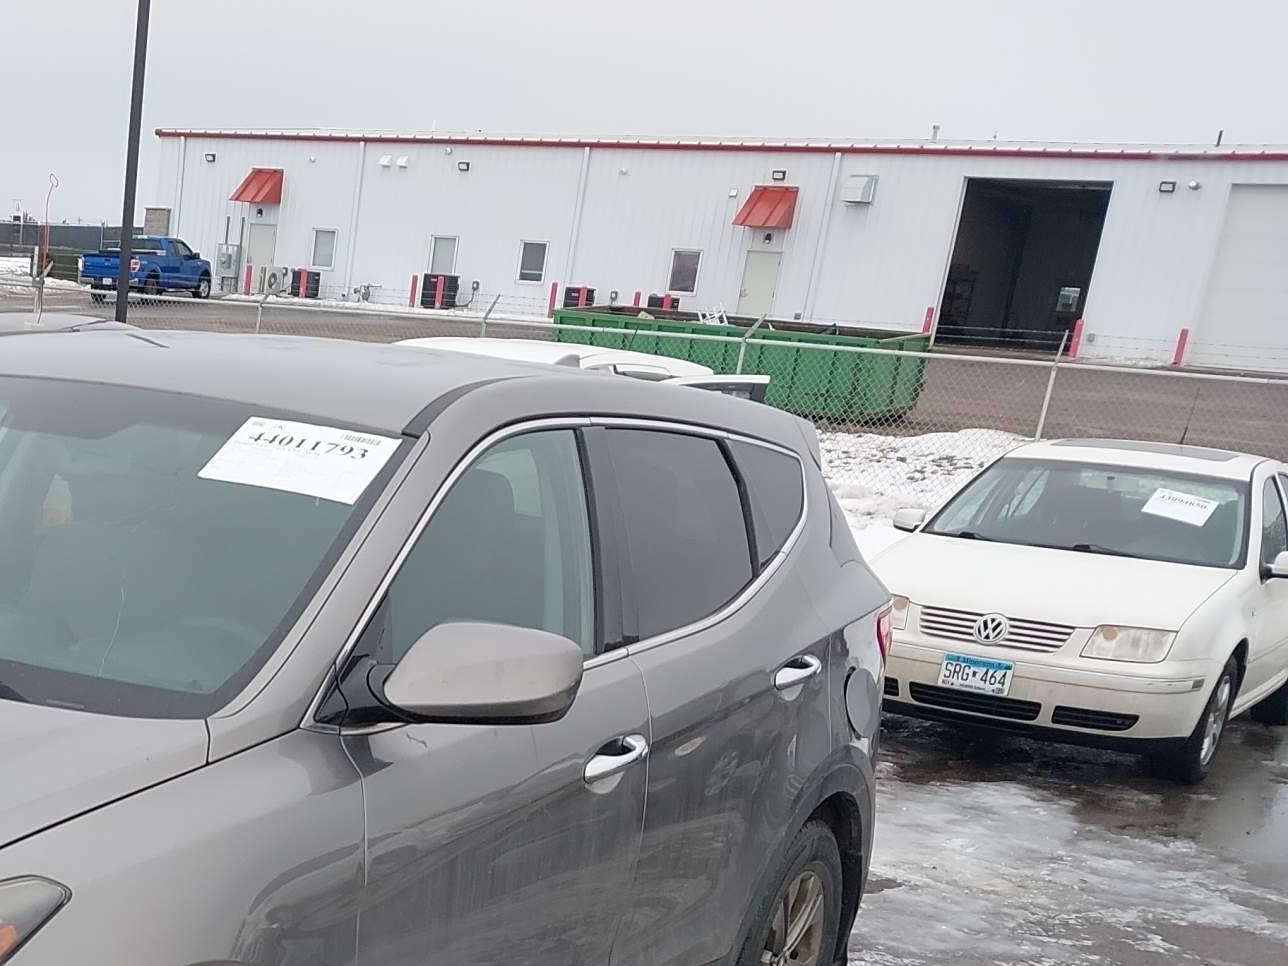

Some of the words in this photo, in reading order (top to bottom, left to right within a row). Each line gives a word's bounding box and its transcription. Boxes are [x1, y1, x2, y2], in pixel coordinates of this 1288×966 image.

[248, 431, 369, 460] 44011793
[943, 661, 972, 682] SRG
[979, 667, 1008, 687] 464
